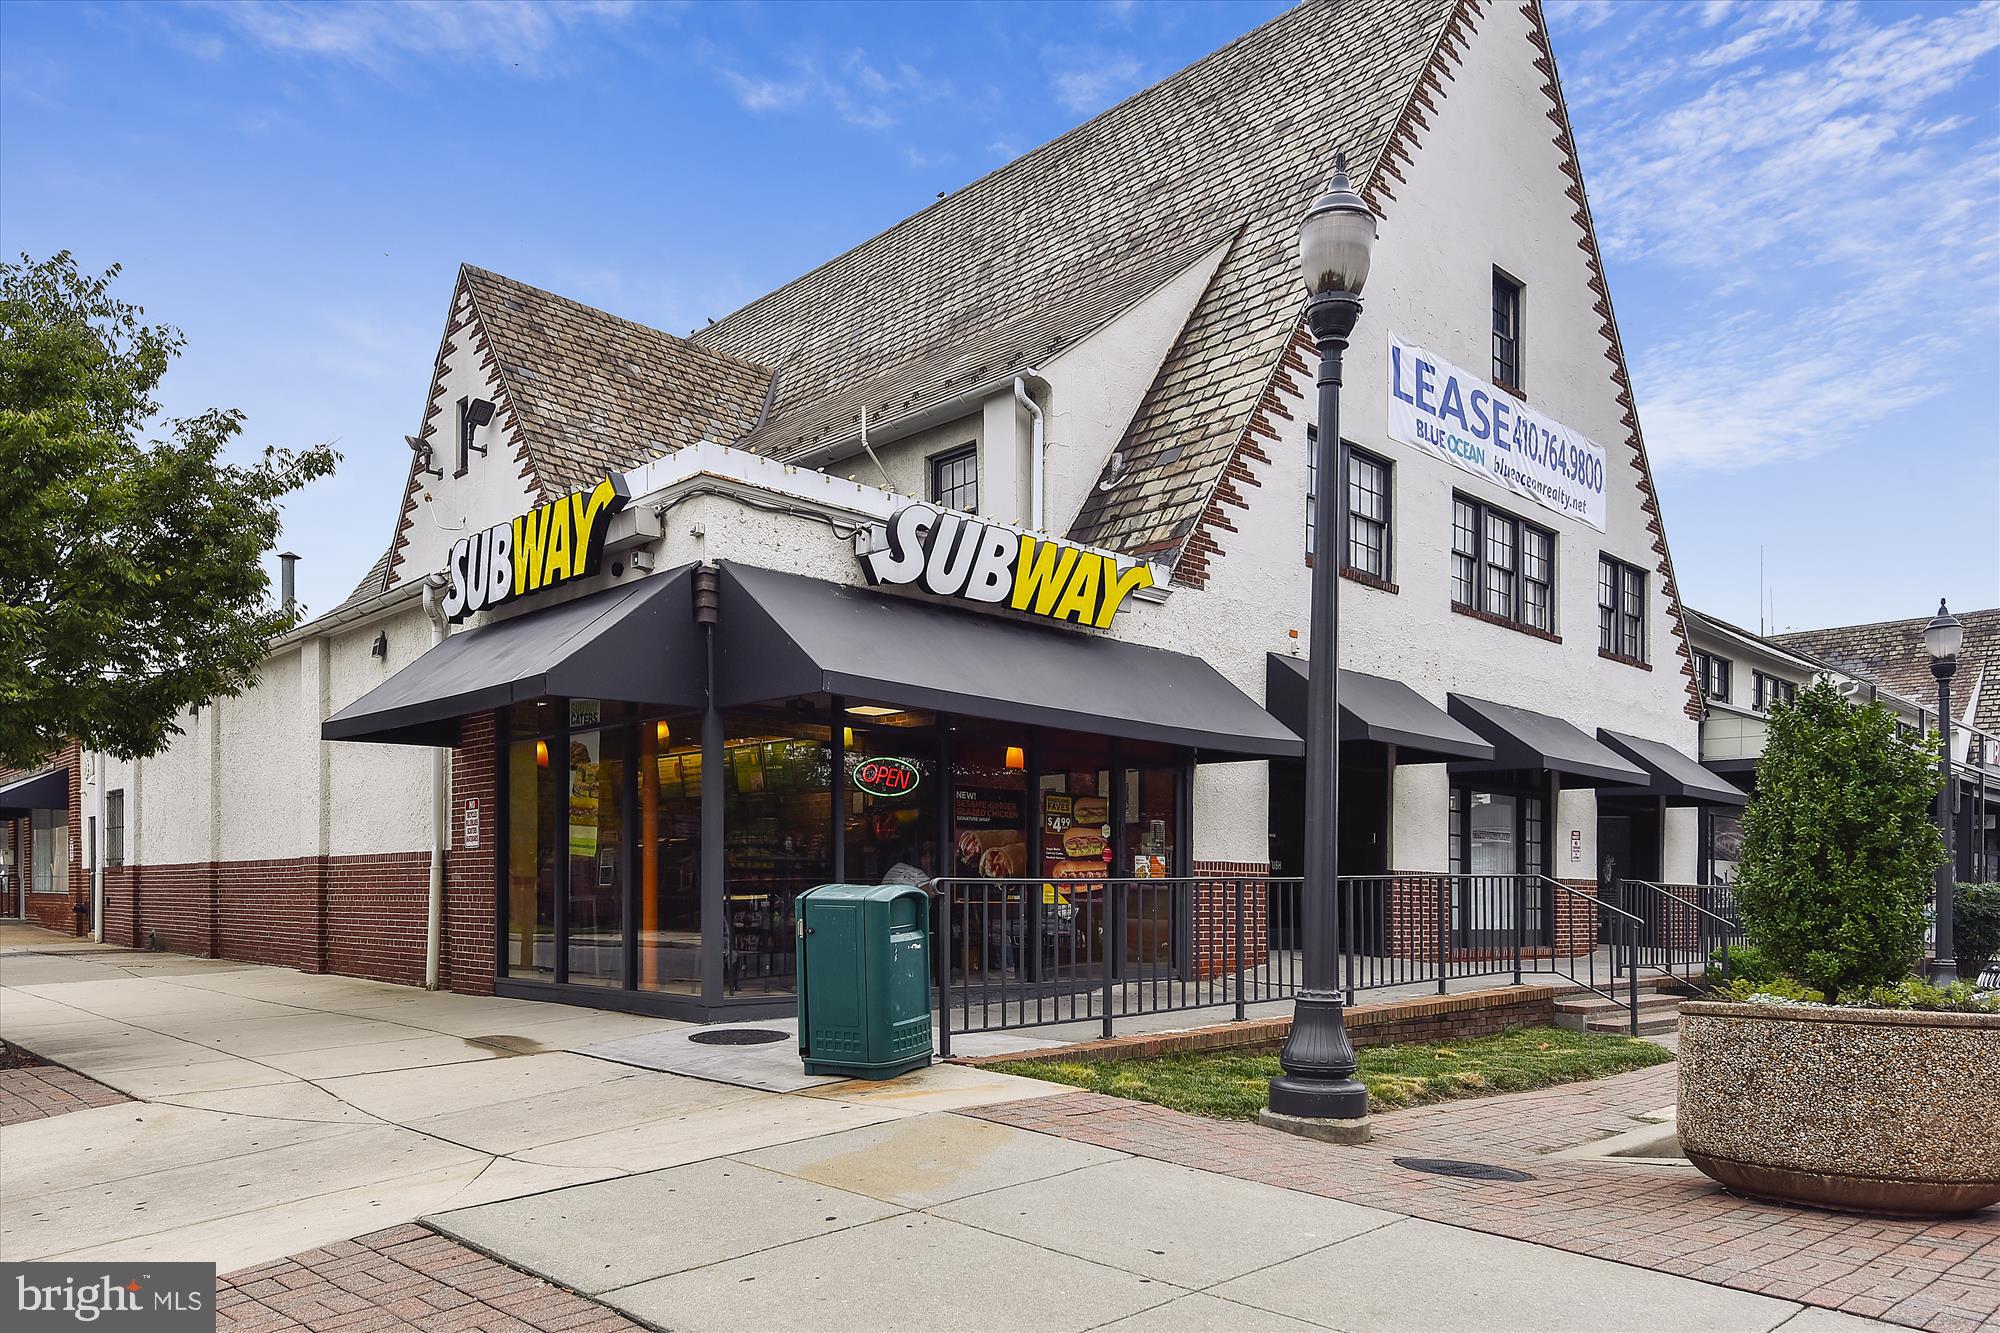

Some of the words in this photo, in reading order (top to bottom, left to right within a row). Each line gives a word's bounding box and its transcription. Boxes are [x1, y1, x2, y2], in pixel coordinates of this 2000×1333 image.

[1392, 345, 1511, 452] LEASE
[1513, 416, 1602, 494] 410.764.9800
[1416, 419, 1446, 449] BLUE
[1448, 434, 1485, 467] OCEAN
[1494, 456, 1587, 514] blueoceanrealty.net
[442, 473, 617, 618] SUBWAY
[869, 504, 1155, 630] SUBWAY
[570, 711, 598, 726] CATERS
[863, 763, 911, 790] OPEN
[955, 790, 977, 800] NEW!
[1048, 802, 1070, 811] FAVES
